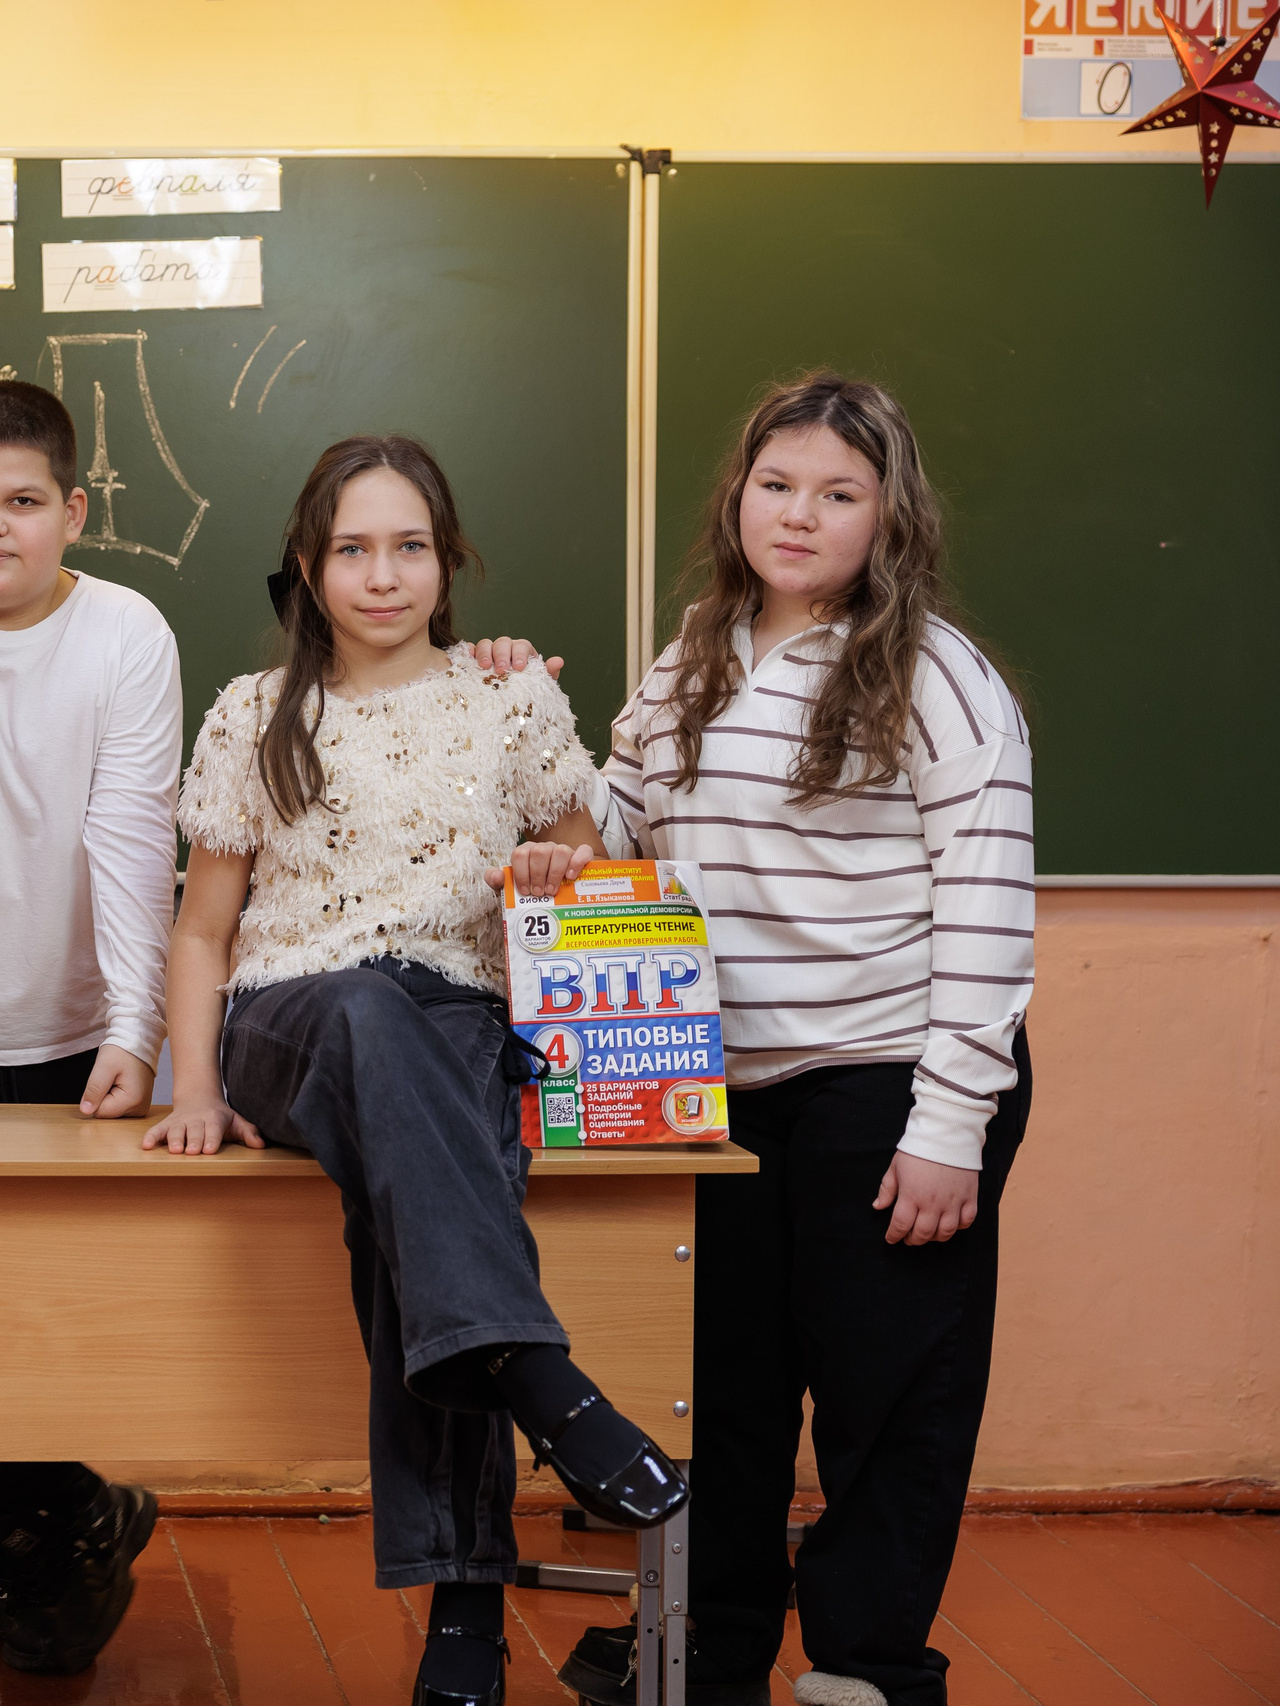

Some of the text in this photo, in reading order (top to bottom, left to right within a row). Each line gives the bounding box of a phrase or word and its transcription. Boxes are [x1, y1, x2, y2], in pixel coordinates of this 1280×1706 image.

[519, 896, 549, 904] ФИОКО
[572, 908, 595, 917] НОВОЙ
[596, 906, 649, 916] ОФИЦИАЛЬНОЙ
[650, 906, 693, 915] ДЕМОВЕРСИИ
[524, 915, 550, 937] 25
[565, 921, 696, 936] ЛИТЕРАТУРНОЕ ЧТЕНИЕ
[565, 936, 698, 949] ВСЕРОССИЙСКАЯ ПРОВЕРОЧНАЯ РАБОТА
[531, 950, 701, 1018] ВПР
[583, 1024, 710, 1049] ТИПОВЫЕ
[544, 1033, 569, 1069] 4
[586, 1050, 709, 1077] ЗАДАНИЯ
[542, 1079, 575, 1088] класс
[586, 1081, 659, 1093] 25 ВАРИАНТОВ
[587, 1090, 634, 1102] ЗАДАНИЙ
[588, 1103, 643, 1113] Подробные
[588, 1111, 632, 1121] критерии
[589, 1119, 645, 1129] оценивания
[590, 1130, 626, 1140] Ответы
